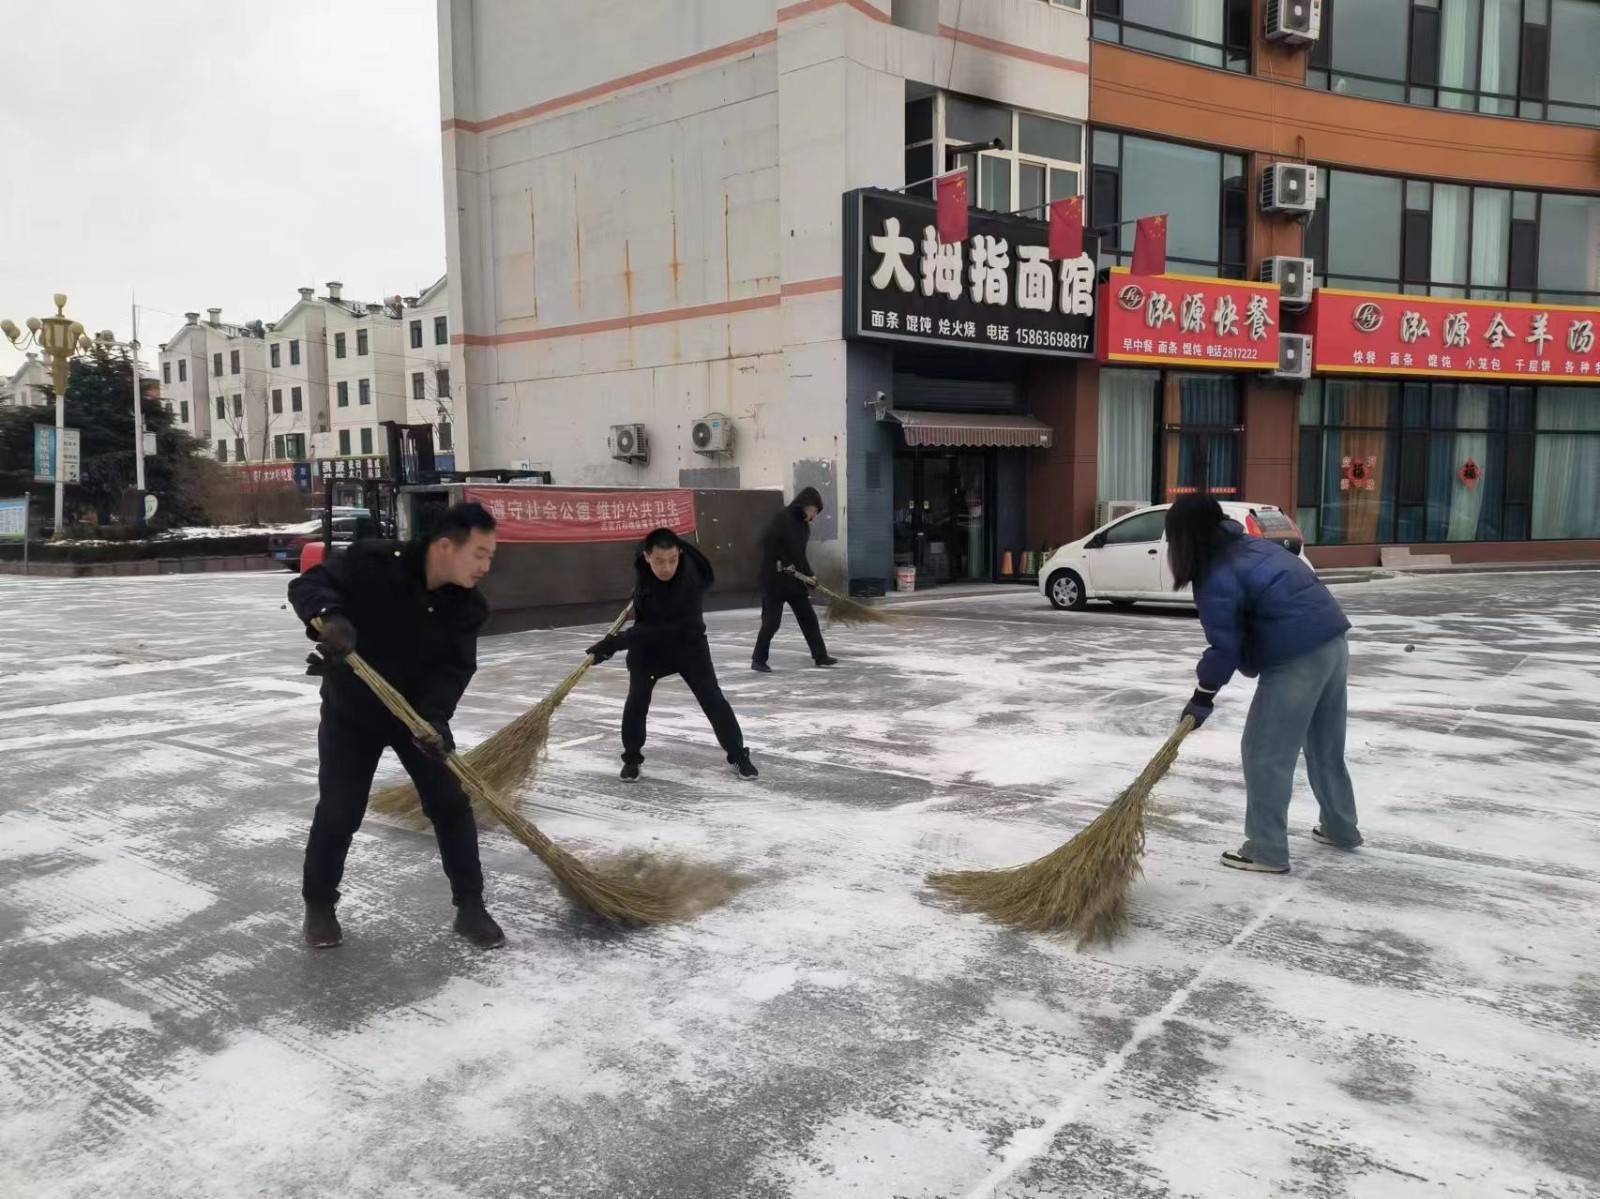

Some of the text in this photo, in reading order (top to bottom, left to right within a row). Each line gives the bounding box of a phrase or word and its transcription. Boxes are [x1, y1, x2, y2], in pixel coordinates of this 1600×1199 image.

[869, 217, 1095, 317] 大拇指面馆
[871, 310, 1089, 350] 面条 馄饨 烩火烧 电话 15863698817
[1147, 291, 1274, 341] 泓源快餐
[1400, 310, 1596, 356] 泓源全羊汤
[1123, 338, 1153, 353] 早中餐
[1158, 340, 1178, 354] 面条
[1353, 350, 1376, 365] 快餐
[1389, 352, 1413, 366] 面条
[1466, 357, 1501, 371] 小笼包
[597, 499, 679, 520] 维护公共卫生
